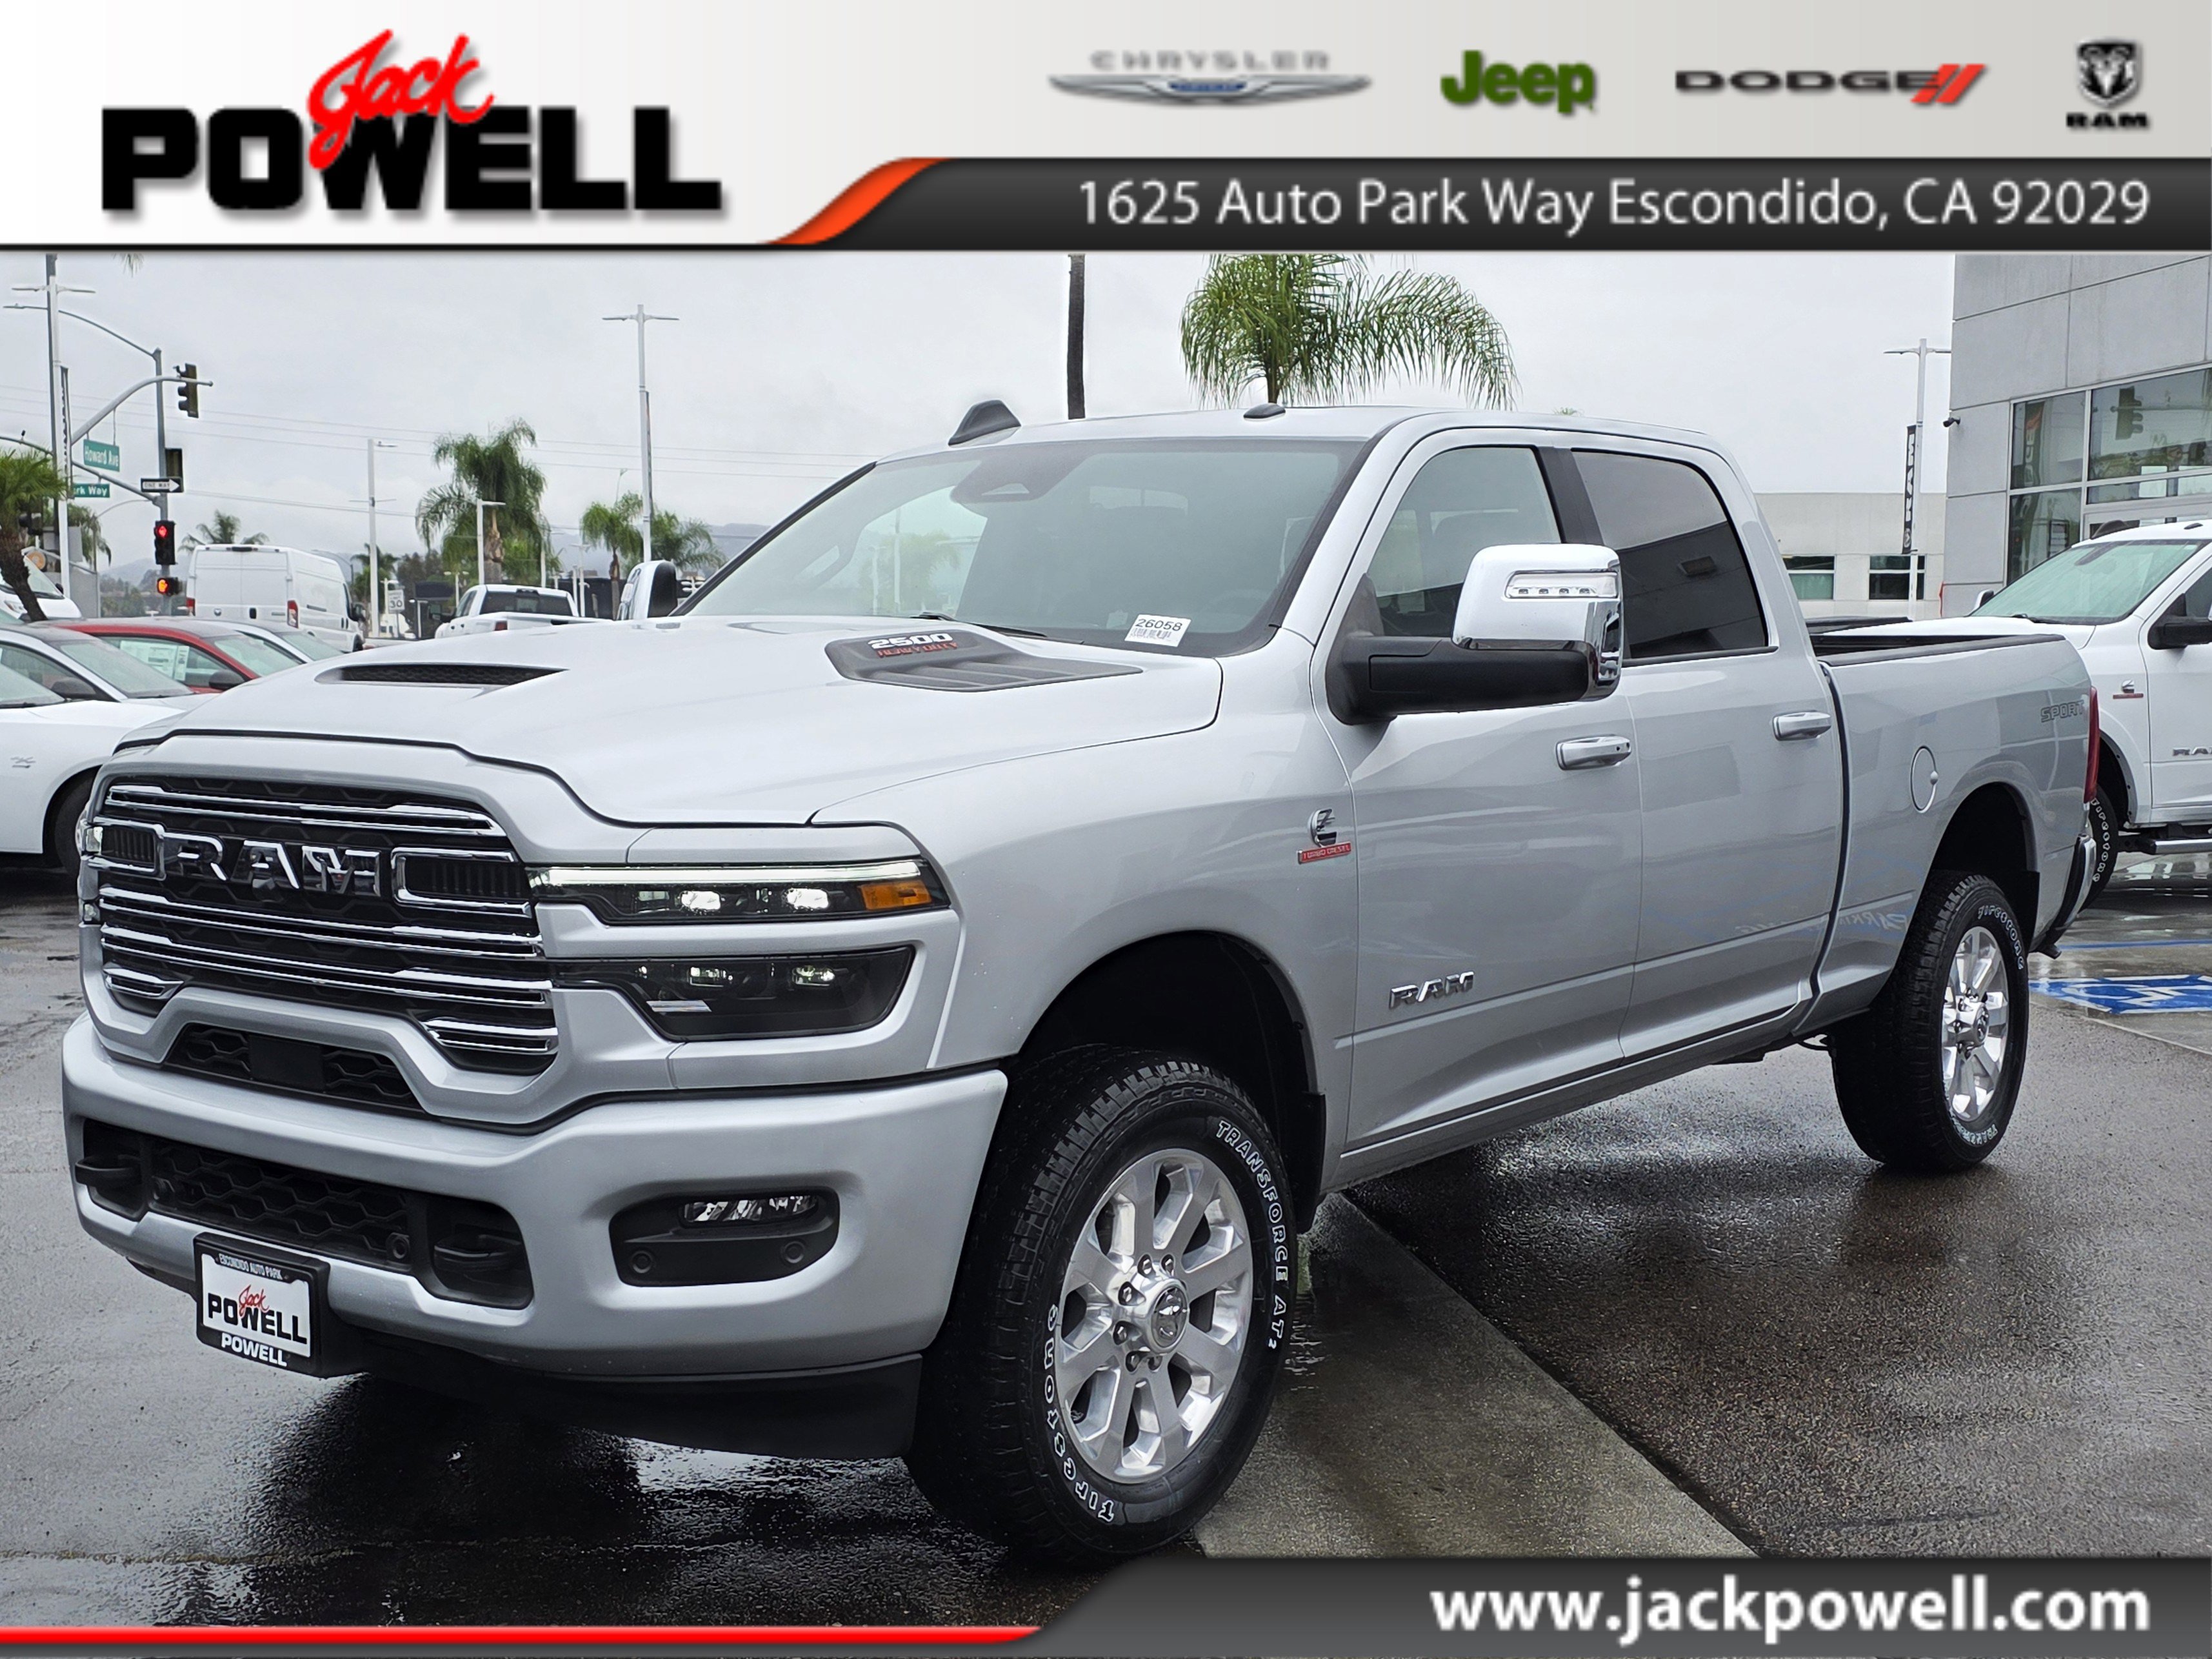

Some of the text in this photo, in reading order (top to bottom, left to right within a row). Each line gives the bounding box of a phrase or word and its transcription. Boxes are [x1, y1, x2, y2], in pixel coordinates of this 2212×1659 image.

[85, 445, 119, 467] Howard Ave
[88, 486, 108, 496] Way
[1135, 619, 1182, 631] 26058
[868, 633, 953, 649] 2500
[2040, 699, 2084, 723] SPORT
[2173, 747, 2212, 756] RA
[163, 832, 381, 898] RAM
[1389, 971, 1474, 1010] RAM
[1215, 1120, 1289, 1282] TRANSFORCE
[239, 1285, 270, 1318] Jack
[208, 1292, 308, 1345] POWELL
[221, 1332, 288, 1367] POWELL
